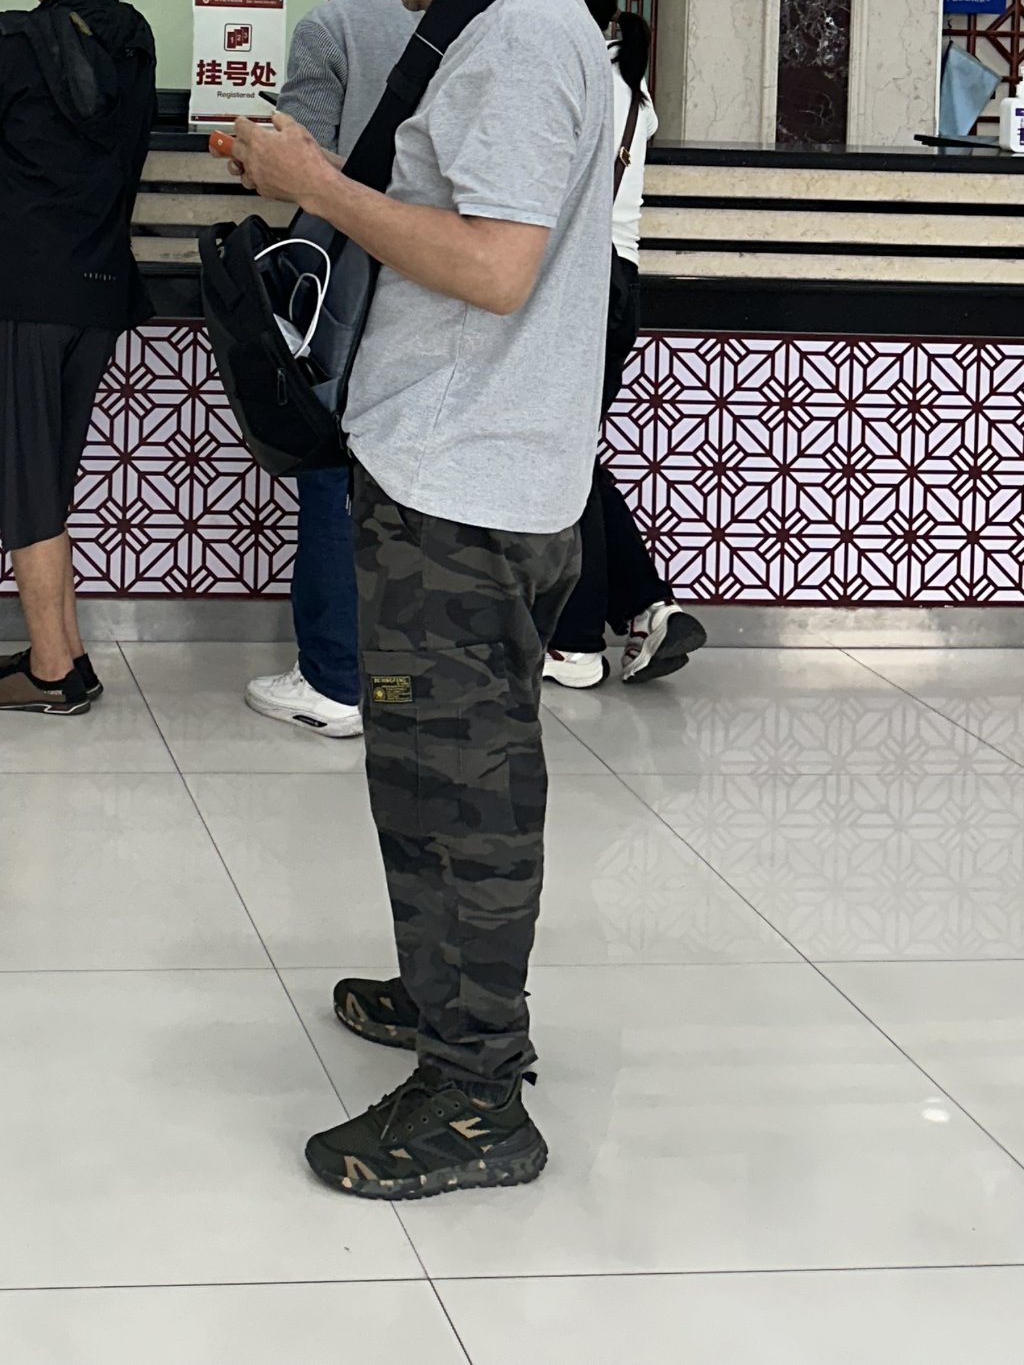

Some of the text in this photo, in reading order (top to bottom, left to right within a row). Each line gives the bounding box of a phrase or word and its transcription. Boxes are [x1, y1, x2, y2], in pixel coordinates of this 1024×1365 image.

[196, 59, 277, 87] 挂号处
[217, 91, 255, 99] Registered
